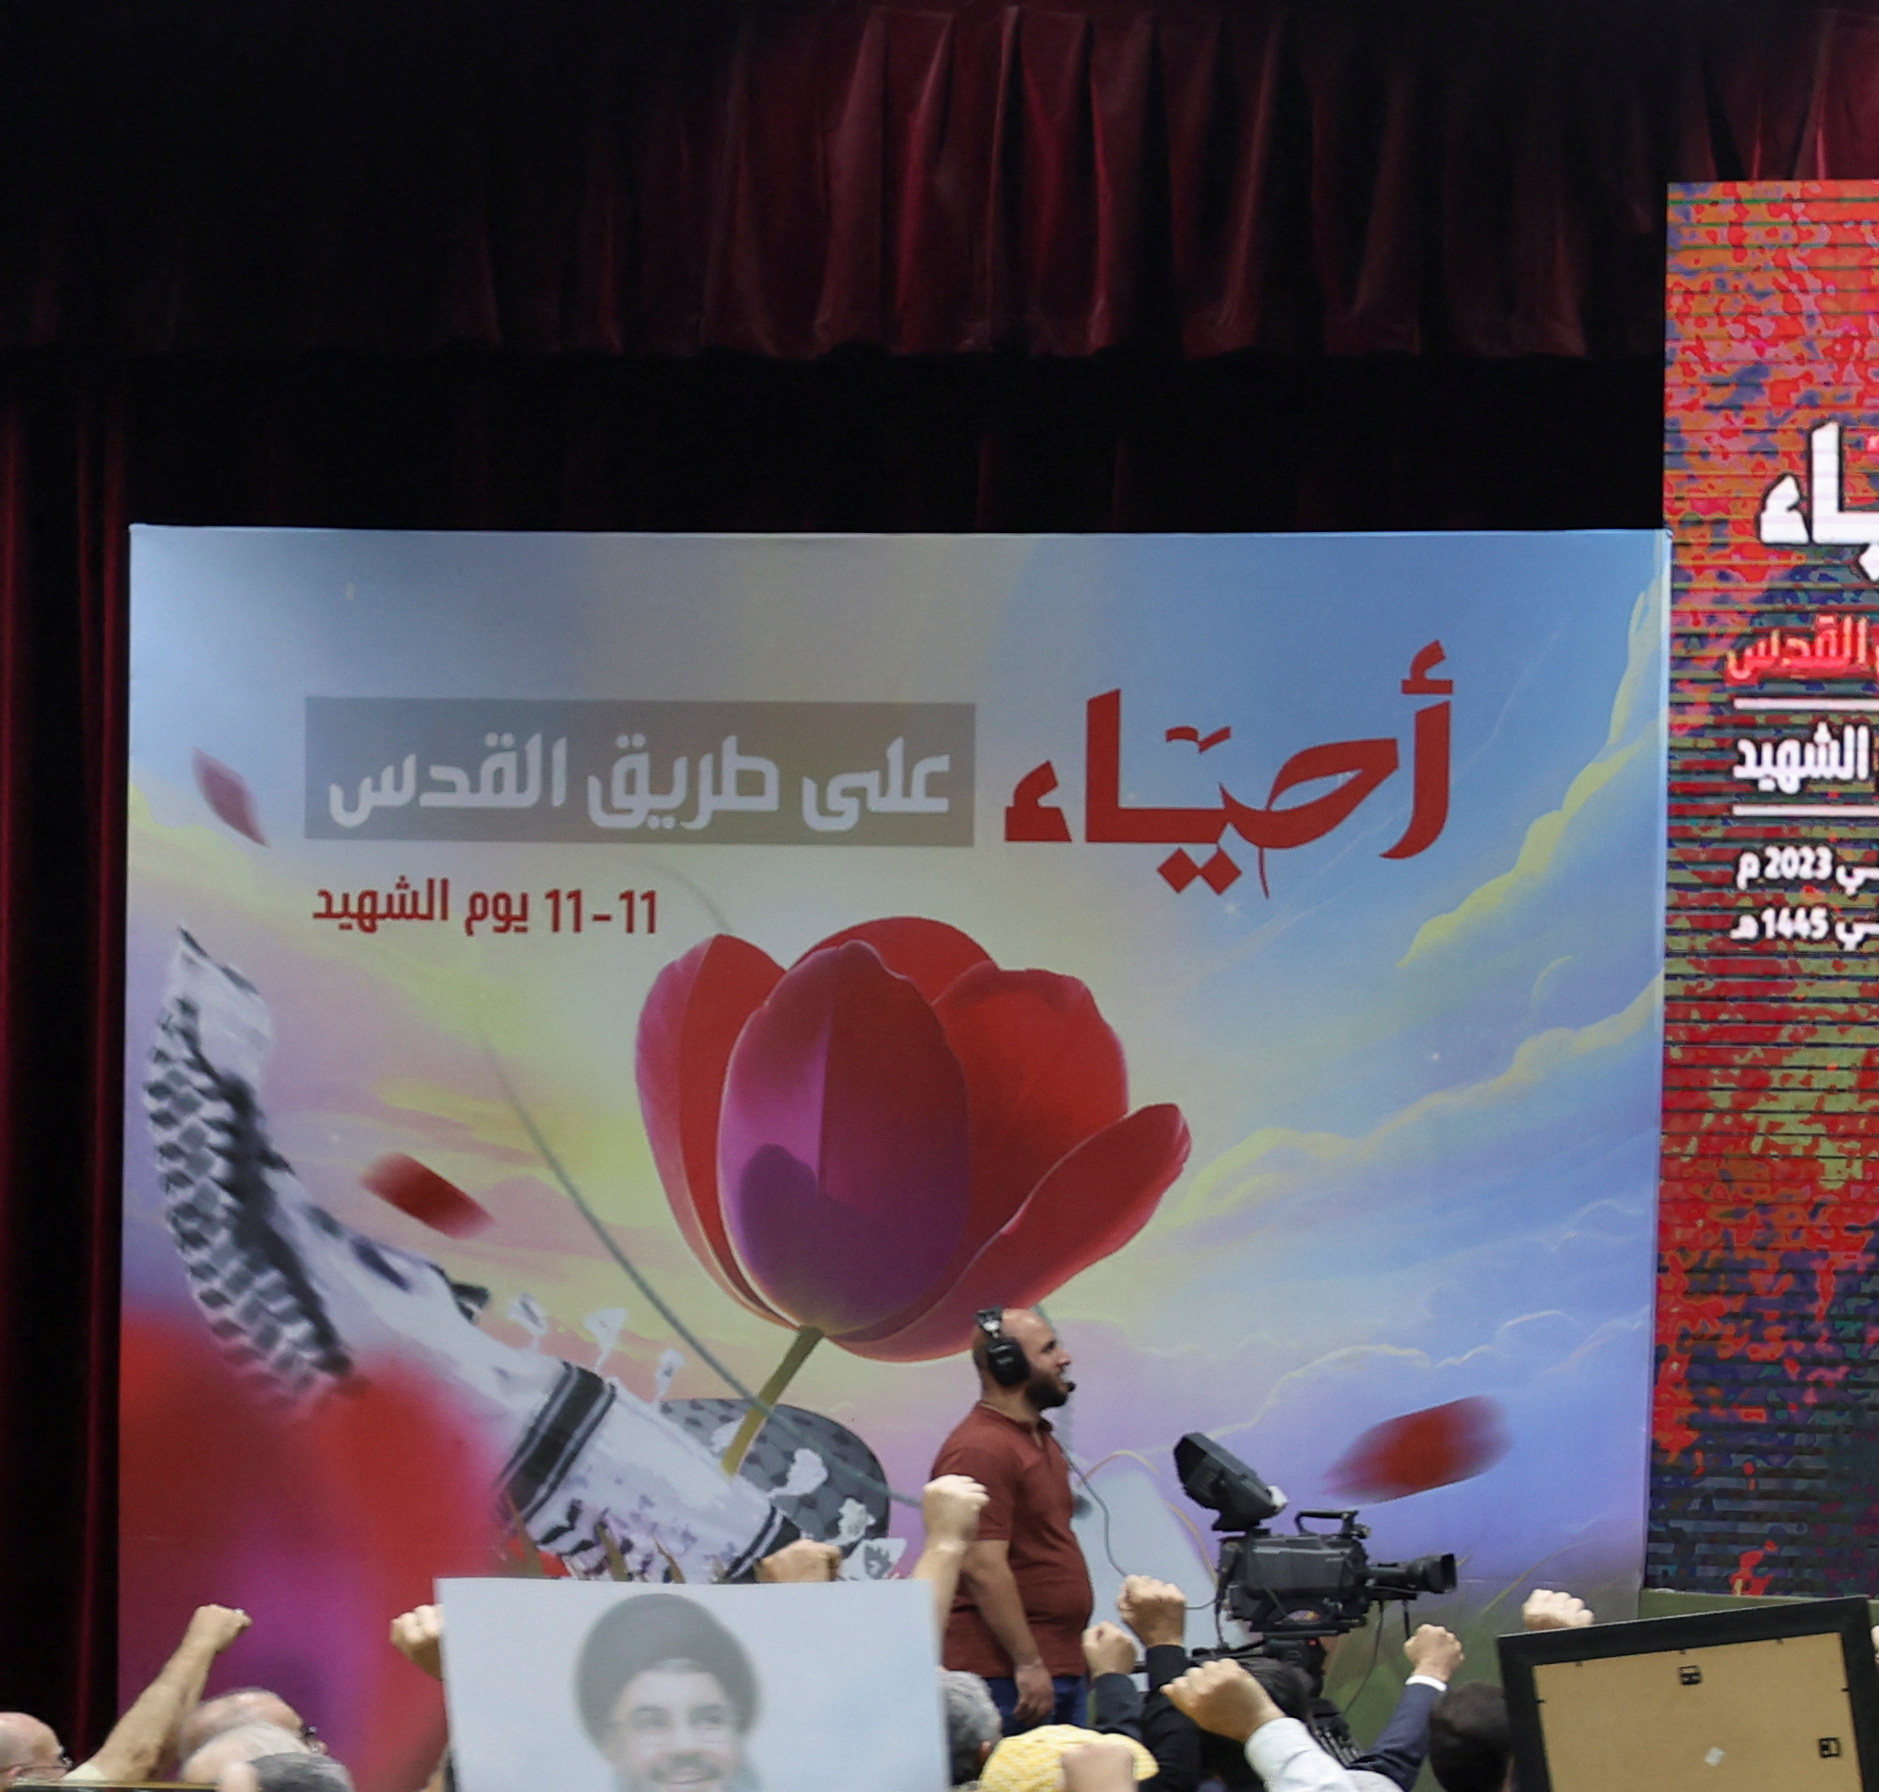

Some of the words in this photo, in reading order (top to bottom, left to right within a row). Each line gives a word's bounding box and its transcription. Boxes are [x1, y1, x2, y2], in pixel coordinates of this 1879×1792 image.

[1727, 614, 1868, 680] القدس
[327, 730, 567, 829] القدس
[586, 733, 780, 831] طريق
[802, 731, 951, 833] على
[1733, 722, 1870, 794] الشهيد
[312, 876, 449, 933] الشهيد
[464, 889, 530, 935] يوم
[544, 889, 658, 934] 11-11
